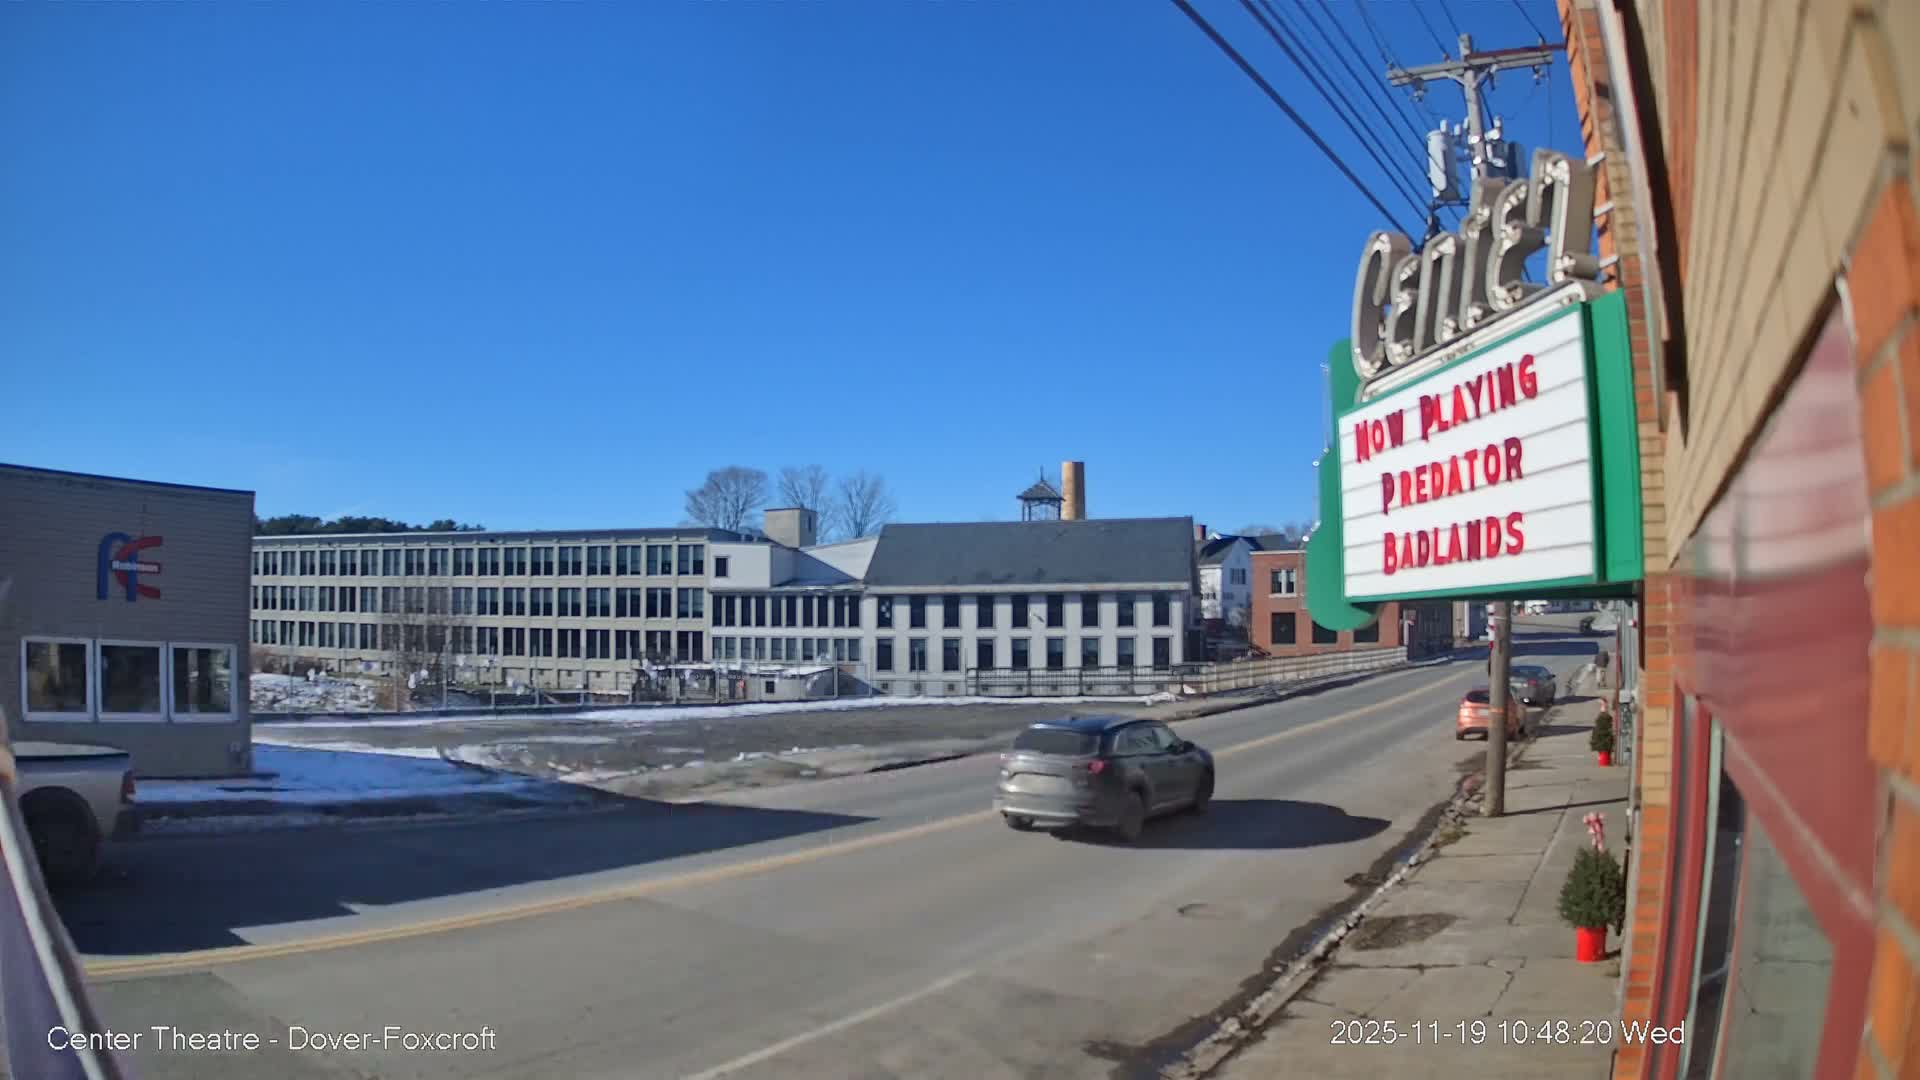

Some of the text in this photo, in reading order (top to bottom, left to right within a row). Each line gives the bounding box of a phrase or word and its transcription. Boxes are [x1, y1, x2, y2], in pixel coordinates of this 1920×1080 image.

[1352, 147, 1598, 378] Center
[1355, 354, 1538, 463] NOW PLAYING
[1382, 437, 1523, 515] PREDATOR
[1383, 512, 1524, 575] BADLANDS
